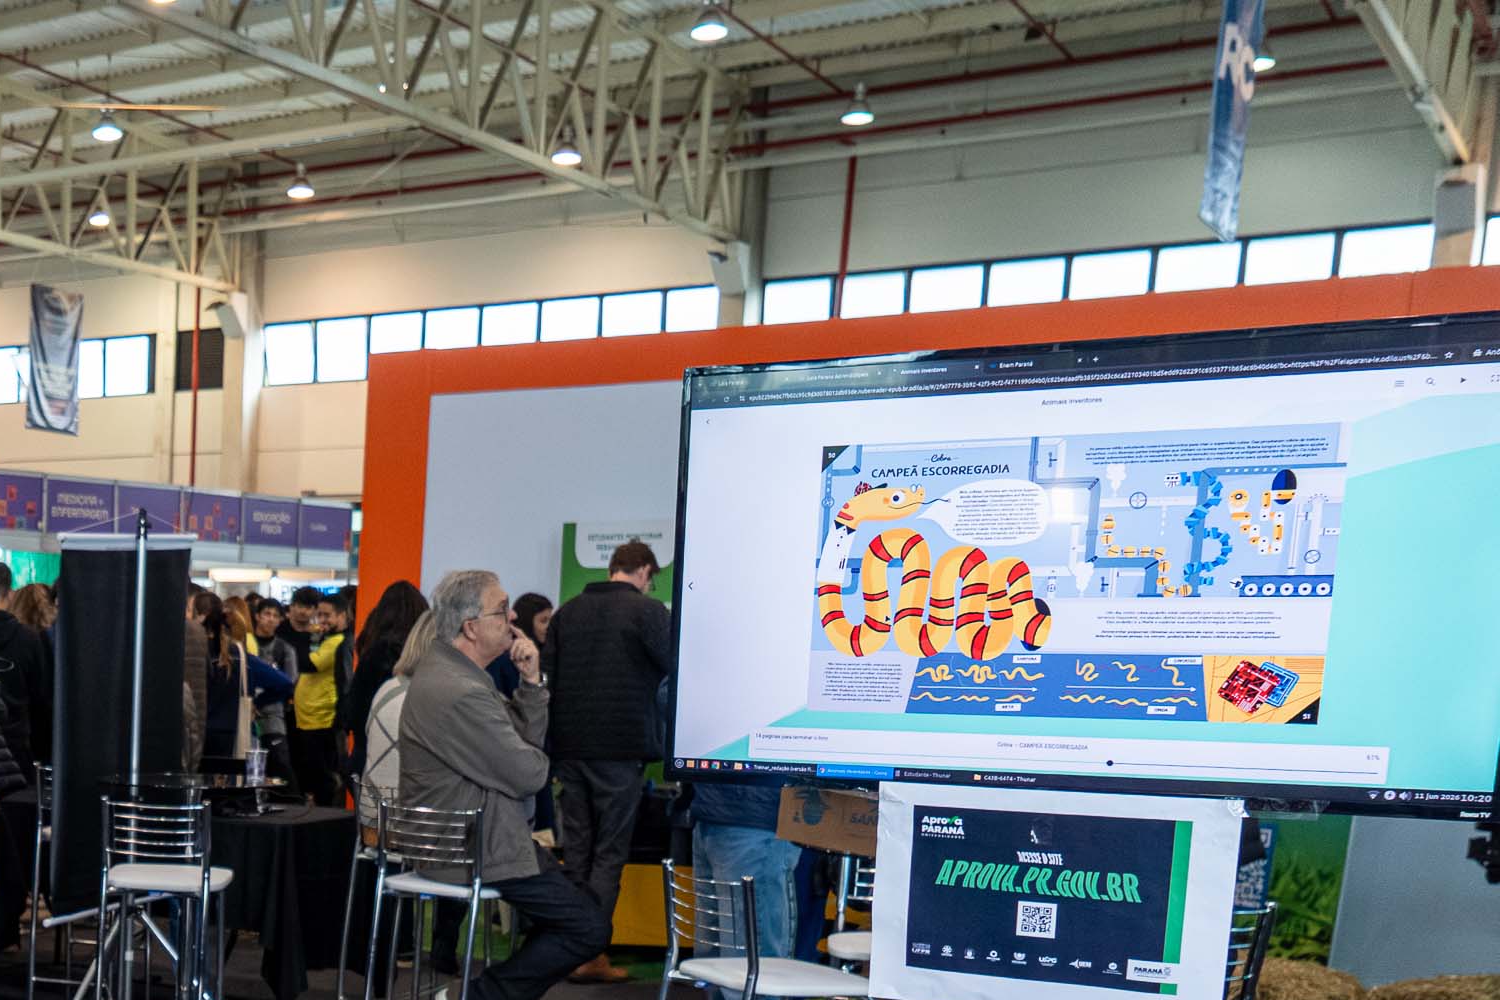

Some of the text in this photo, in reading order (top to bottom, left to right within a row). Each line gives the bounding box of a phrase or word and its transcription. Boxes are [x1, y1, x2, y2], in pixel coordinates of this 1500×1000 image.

[871, 463, 1010, 479] CAMPEÃ ESCORREGADIA
[1016, 775, 1037, 783] Thunar
[1440, 793, 1460, 801] 2026
[1460, 794, 1492, 803] 10:20
[921, 815, 963, 826] Aprova
[921, 824, 965, 836] PARANÁ
[1016, 851, 1043, 864] ACESSE
[1048, 854, 1064, 866] SITE
[934, 858, 1142, 905] APROVA.PR.GOV.BR
